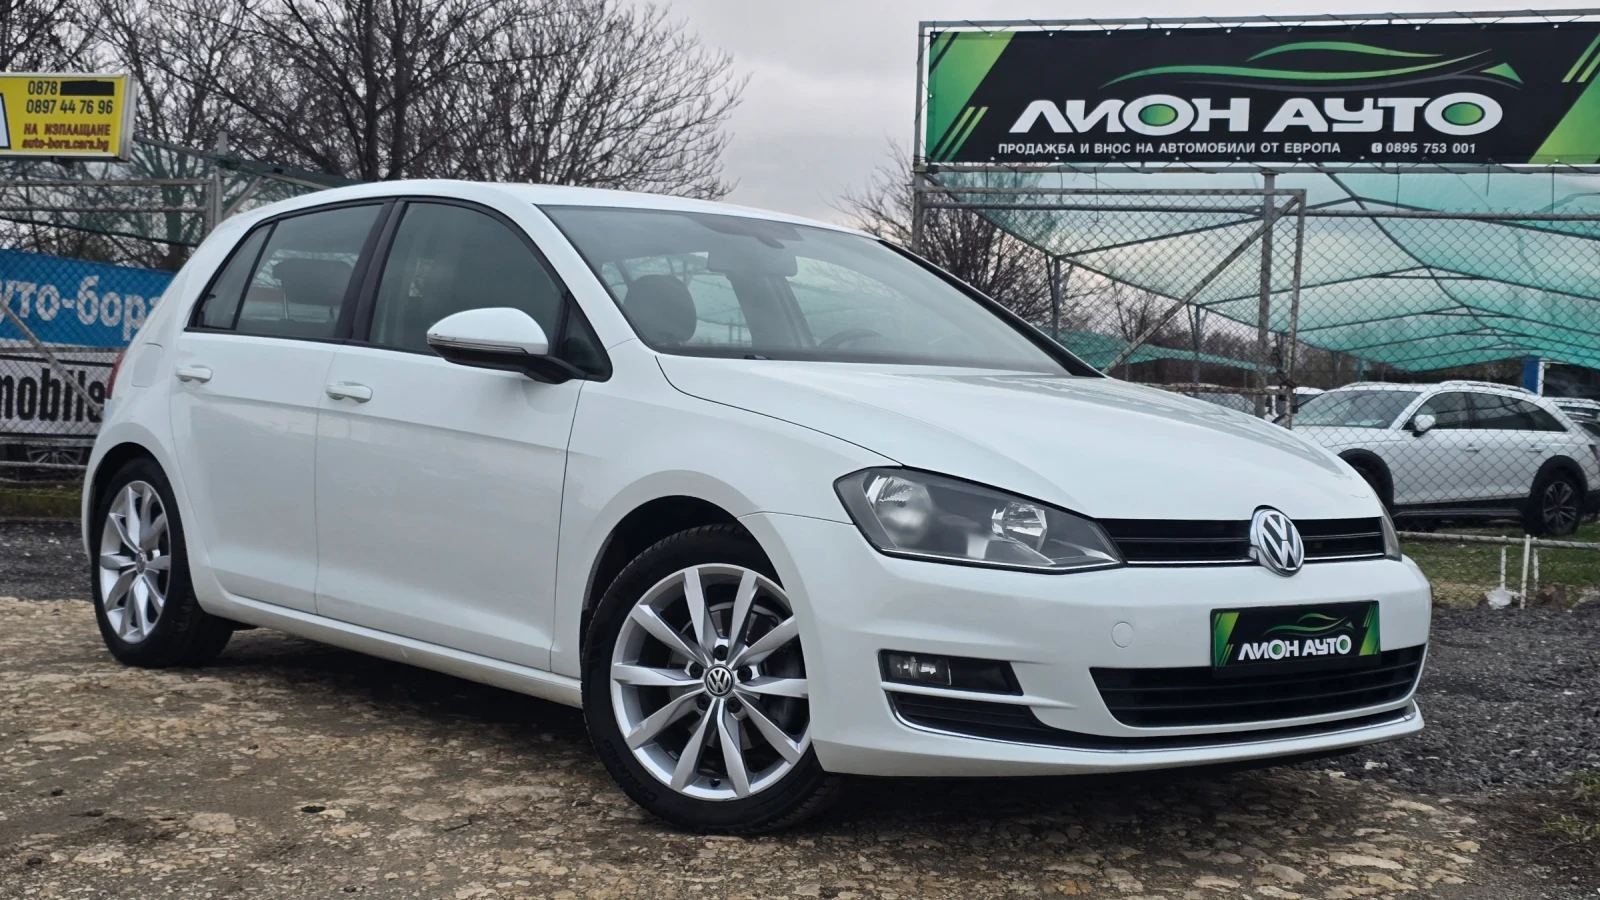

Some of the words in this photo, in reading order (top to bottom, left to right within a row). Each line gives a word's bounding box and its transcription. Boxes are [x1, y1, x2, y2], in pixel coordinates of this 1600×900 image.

[27, 81, 58, 95] 0878
[26, 99, 57, 114] 0897
[60, 100, 76, 114] 44
[79, 100, 94, 114] 76
[98, 100, 113, 114] 96
[1008, 94, 1251, 136] ЛИОН
[1262, 92, 1503, 136] АУТО
[23, 123, 38, 135] НА
[44, 123, 111, 137] ИЗПЛАЩАНЕ
[998, 143, 1076, 155] ПРОДАЖБА
[1080, 143, 1090, 154] И
[1094, 143, 1131, 154] ВНОС
[1136, 143, 1153, 154] НА
[1158, 142, 1256, 154] АВТОМОБИЛИ
[1260, 142, 1280, 154] ОТ
[1284, 142, 1342, 154] ЕВРОПА
[1385, 142, 1418, 154] 0895
[1423, 142, 1447, 154] 753
[1452, 142, 1476, 154] 001
[0, 275, 160, 341] уто-бор
[1238, 639, 1300, 661] ЛИОН
[1302, 634, 1352, 657] АУТО
